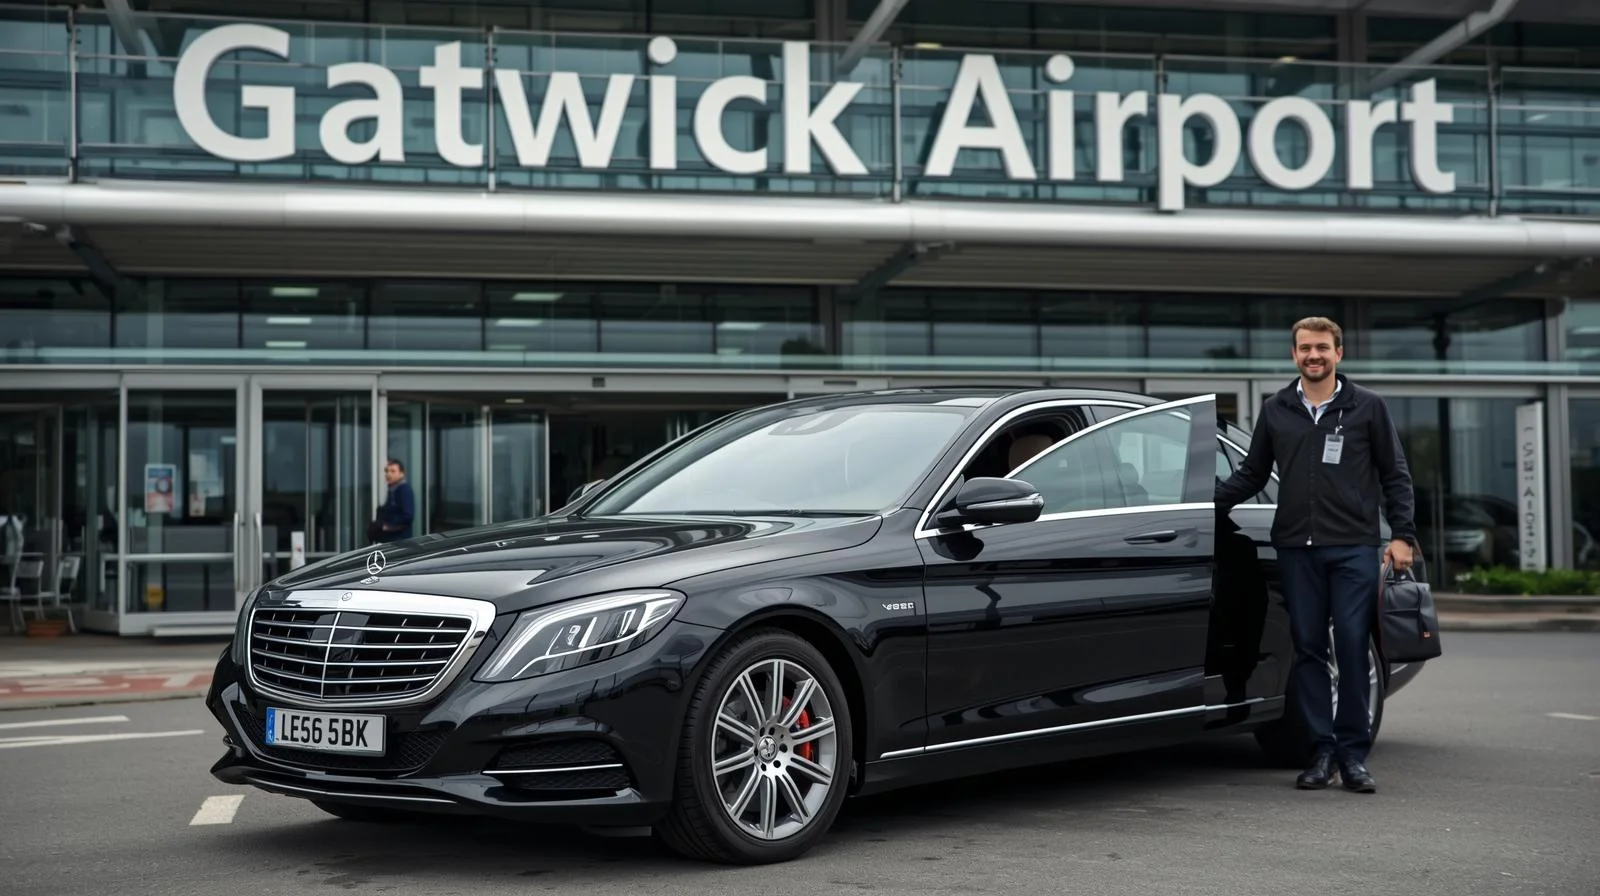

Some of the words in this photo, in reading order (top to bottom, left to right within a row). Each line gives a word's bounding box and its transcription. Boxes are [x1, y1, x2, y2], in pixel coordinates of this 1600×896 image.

[173, 23, 869, 176] Gatwick
[924, 53, 1456, 211] Airport
[281, 713, 322, 744] LE56
[328, 718, 369, 748] 5BK
